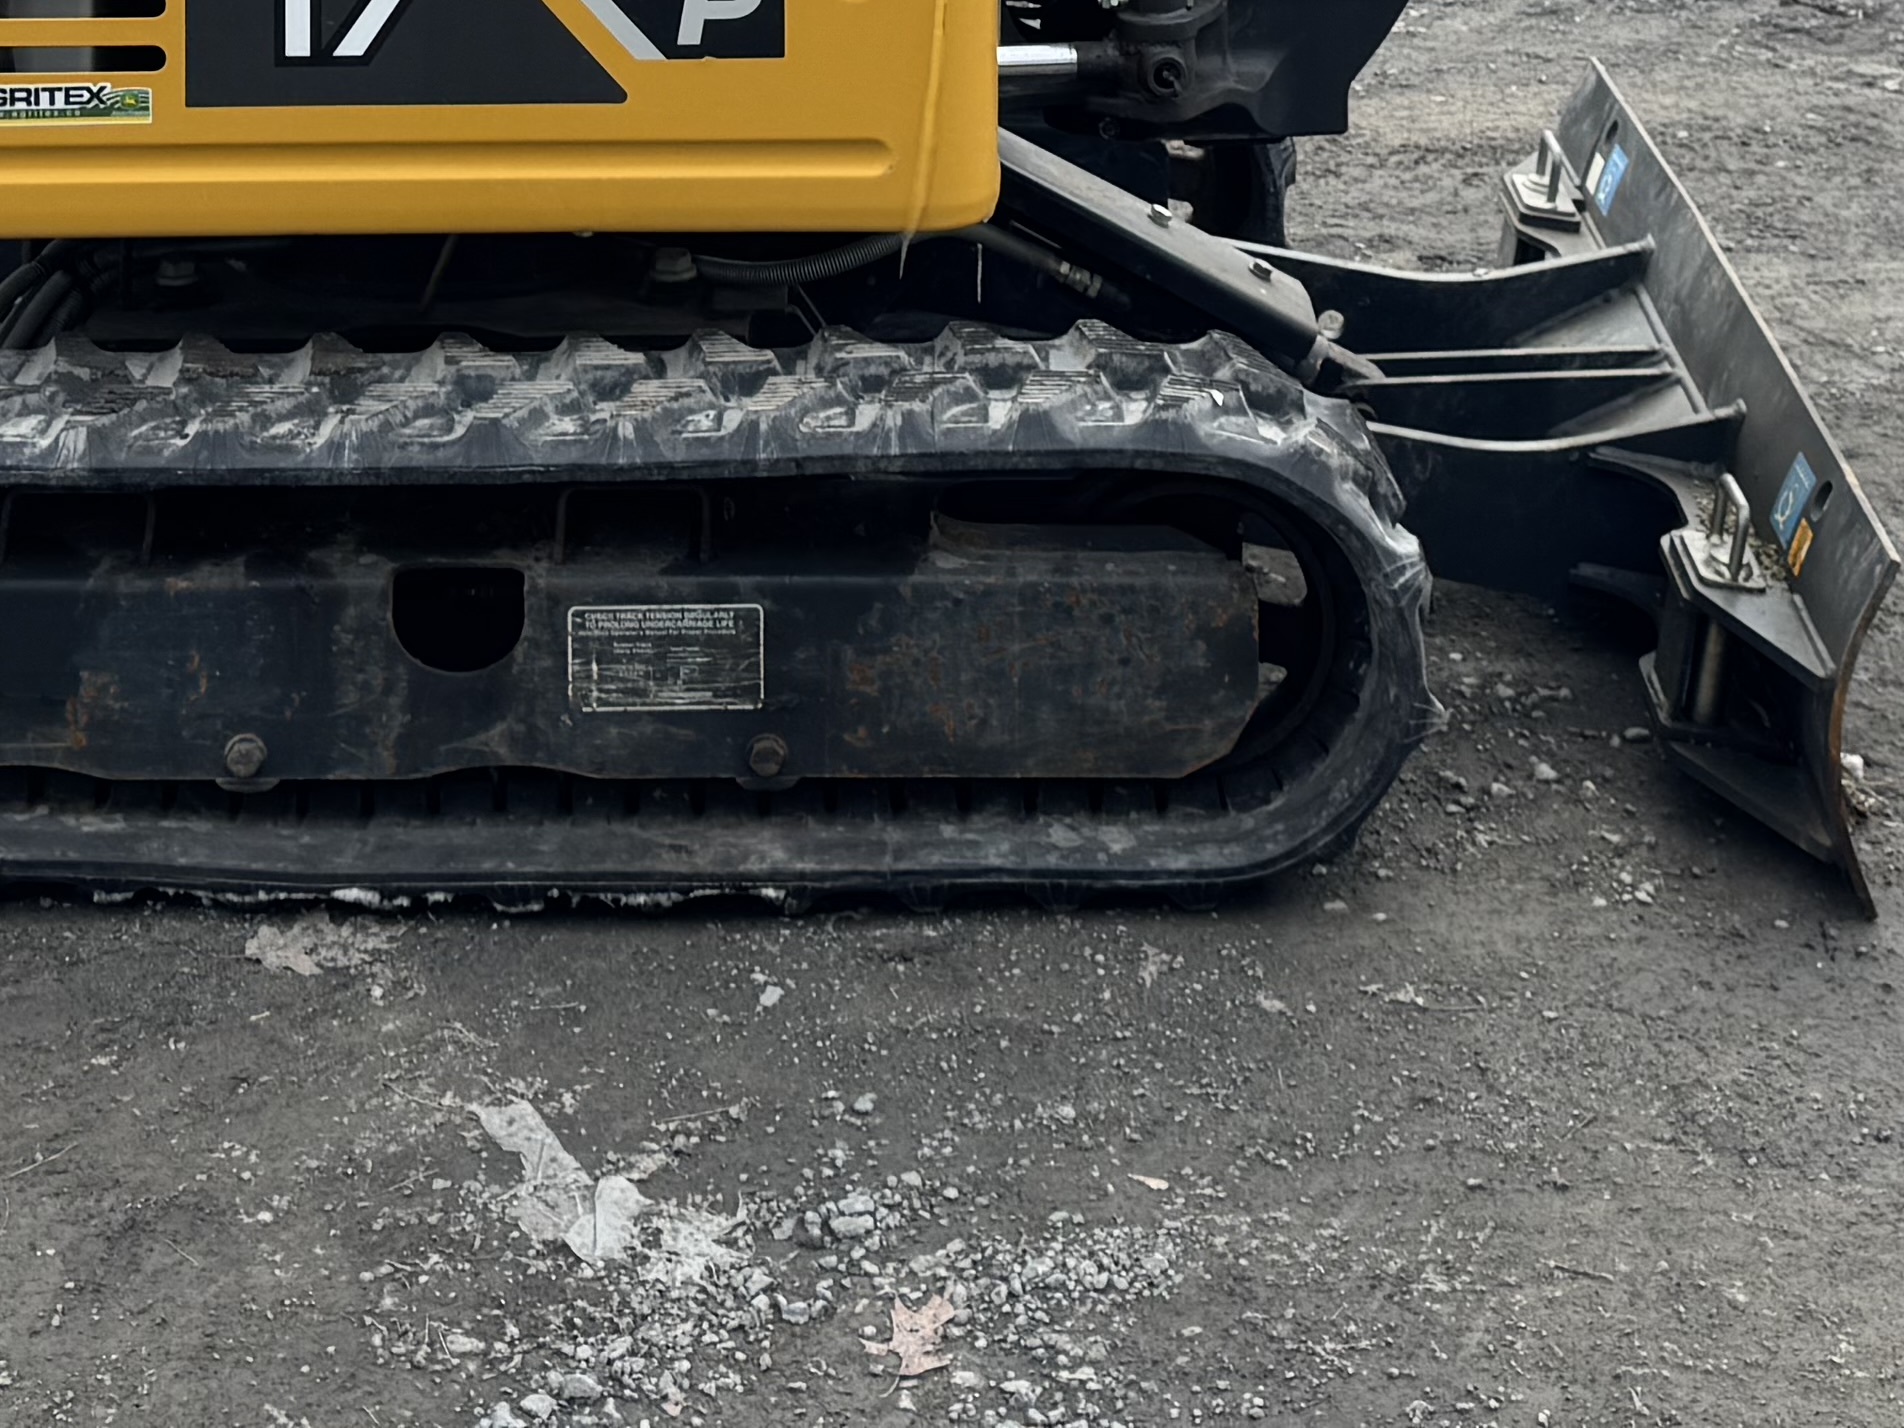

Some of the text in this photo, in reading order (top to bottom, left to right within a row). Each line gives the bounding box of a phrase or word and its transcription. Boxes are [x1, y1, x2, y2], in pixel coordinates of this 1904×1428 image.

[616, 611, 644, 620] TRACK
[646, 611, 683, 620] TENSION
[684, 610, 735, 619] REGULARLY
[598, 620, 640, 629] PROLONG
[641, 619, 714, 629] UNDERCARRIAGE
[715, 619, 735, 628] LIFE
